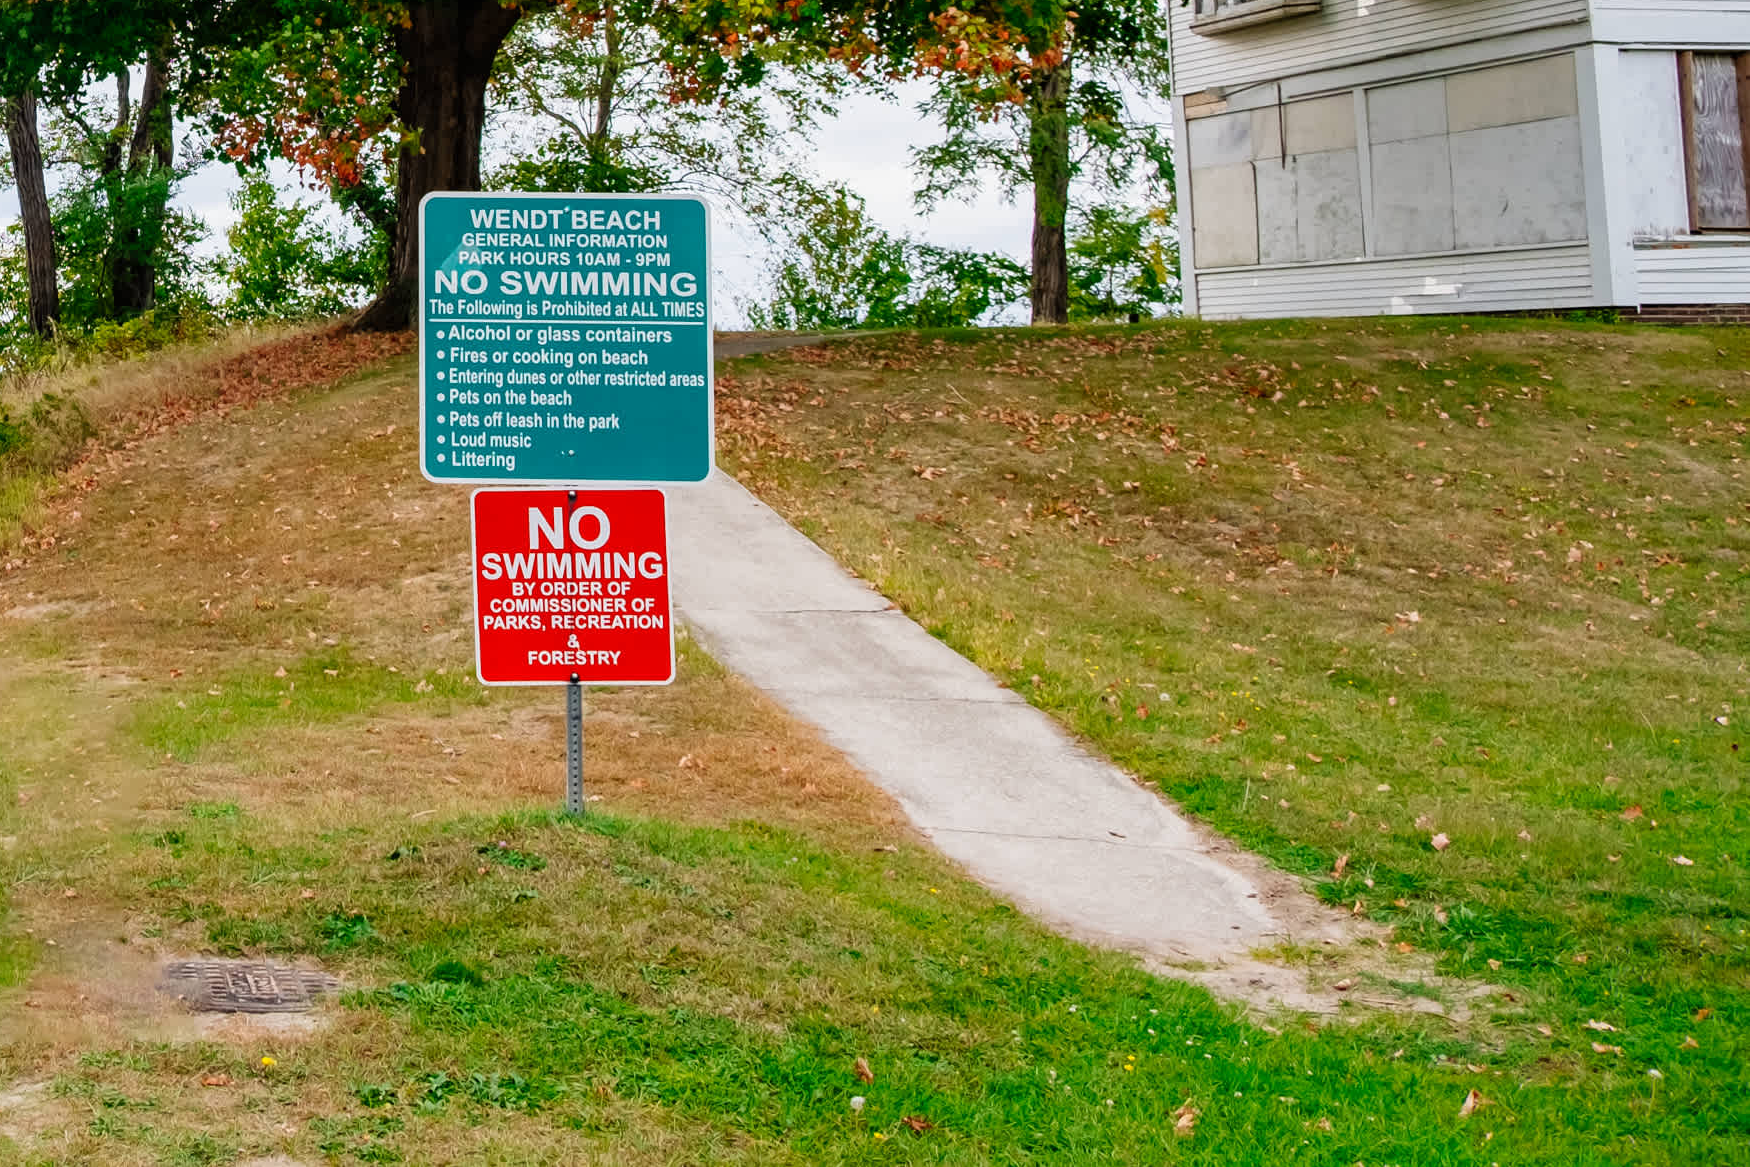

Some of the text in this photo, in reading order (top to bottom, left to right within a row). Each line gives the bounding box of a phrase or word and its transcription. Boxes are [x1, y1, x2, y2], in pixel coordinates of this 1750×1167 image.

[471, 210, 661, 231] WENDT BEACH
[463, 233, 667, 248] GENERAL INFORMATION
[459, 252, 504, 265] PARK
[510, 252, 570, 265] HOURS
[576, 253, 620, 266] 10AM
[636, 253, 670, 267] 9PM
[435, 270, 697, 297] NO SWIMMING
[430, 299, 704, 319] The Following is Prohibited at ALL TIMES
[449, 326, 672, 344] Alcohol or glass containers
[451, 348, 648, 368] Fires or cooking on beach
[450, 370, 705, 387] Entering dunes or other restricted areas
[450, 390, 572, 406] Pets on the beach
[450, 412, 620, 432] Pets off leash in the park
[452, 432, 532, 447] Loud music
[453, 452, 515, 470] Littering
[528, 506, 610, 550] NO
[482, 552, 664, 580] SWIMMING
[512, 582, 630, 596] BY ORDER OF
[490, 599, 655, 613] COMMISSIONER OF
[483, 615, 663, 631] PARKS, RECREATION
[567, 634, 580, 648] &
[528, 651, 621, 665] FORESTRY
